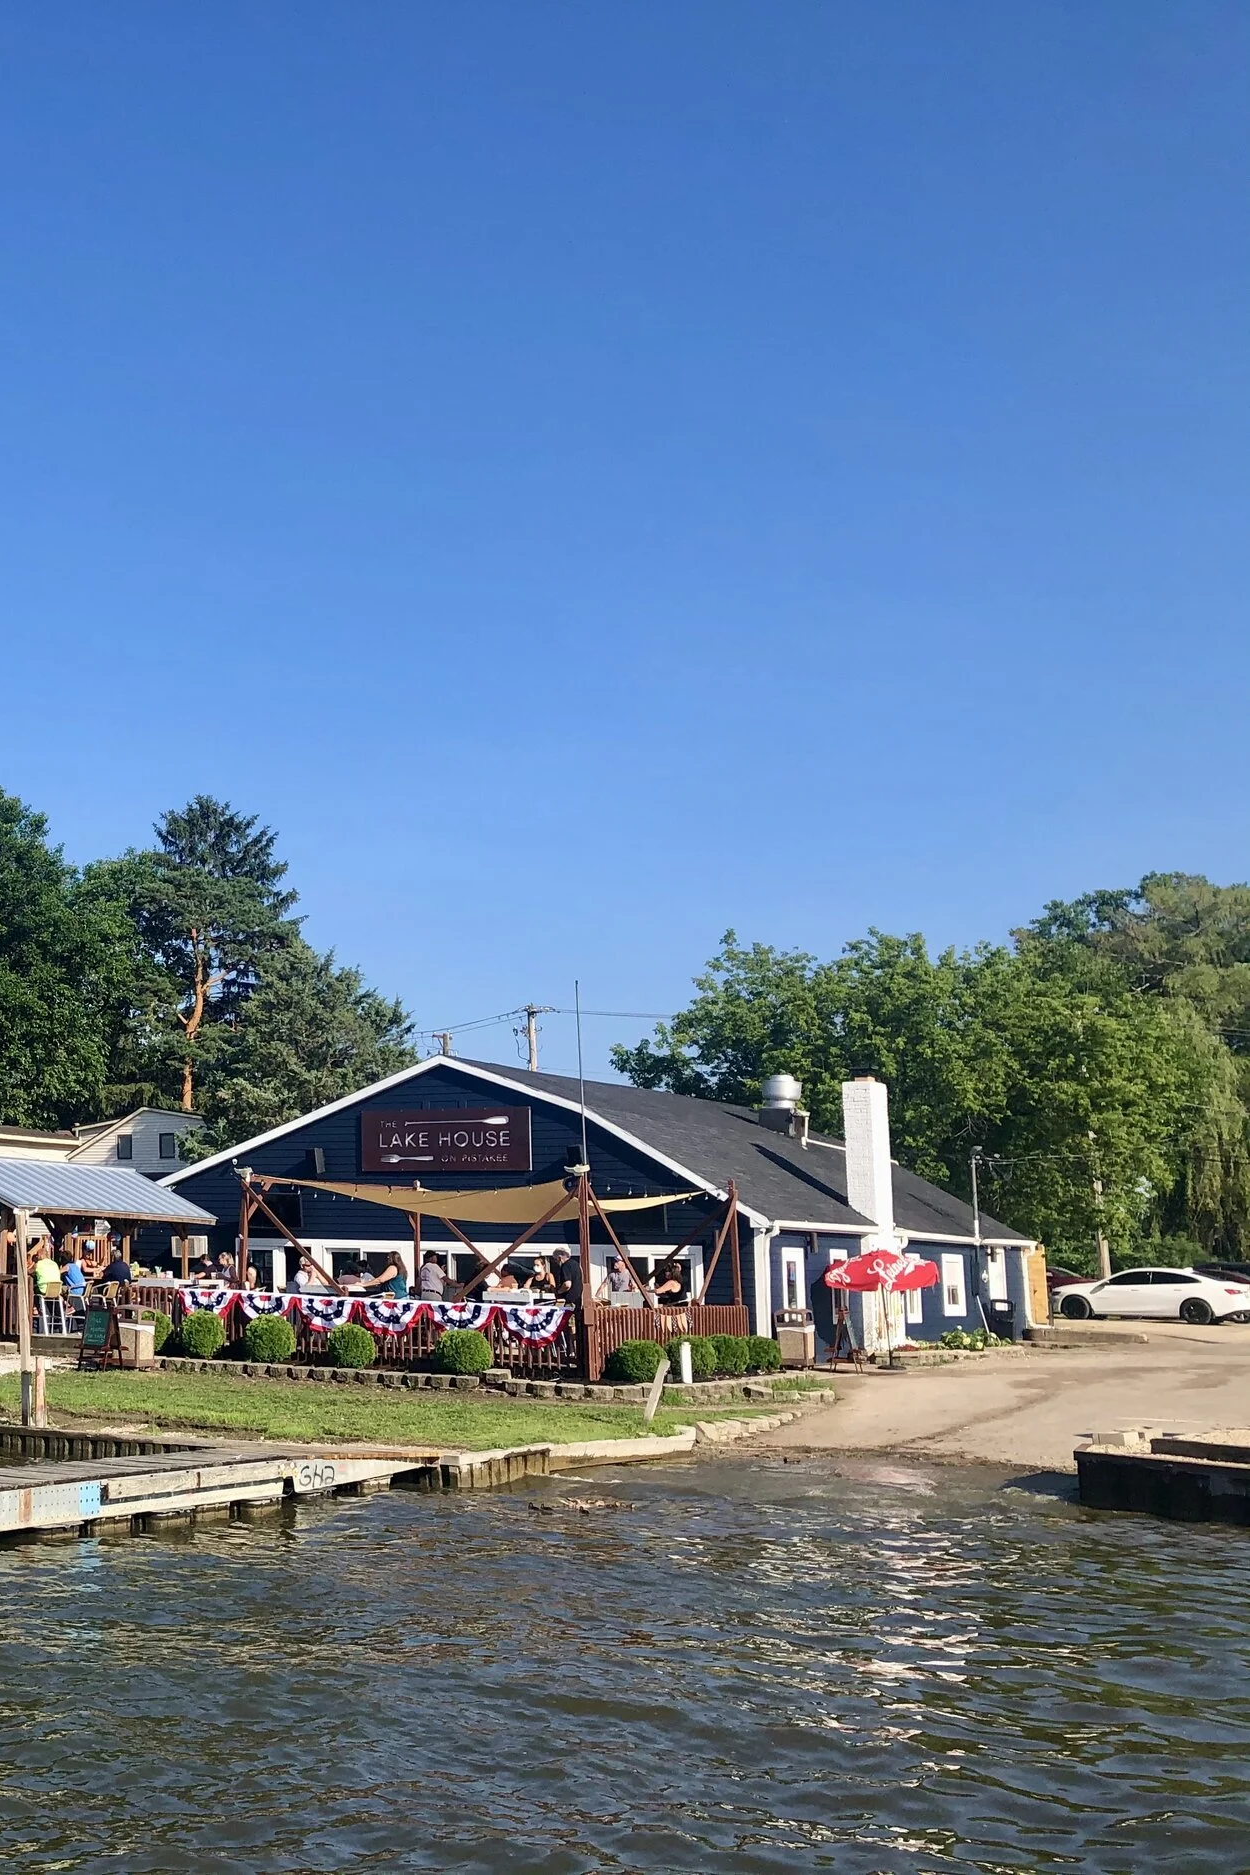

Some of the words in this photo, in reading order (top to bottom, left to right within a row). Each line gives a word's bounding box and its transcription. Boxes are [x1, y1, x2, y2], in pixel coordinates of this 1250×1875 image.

[380, 1120, 397, 1129] THE
[379, 1131, 429, 1148] LAKE
[438, 1130, 511, 1148] HOUSE
[441, 1155, 457, 1163] ON
[461, 1153, 509, 1163] PISTAKEE
